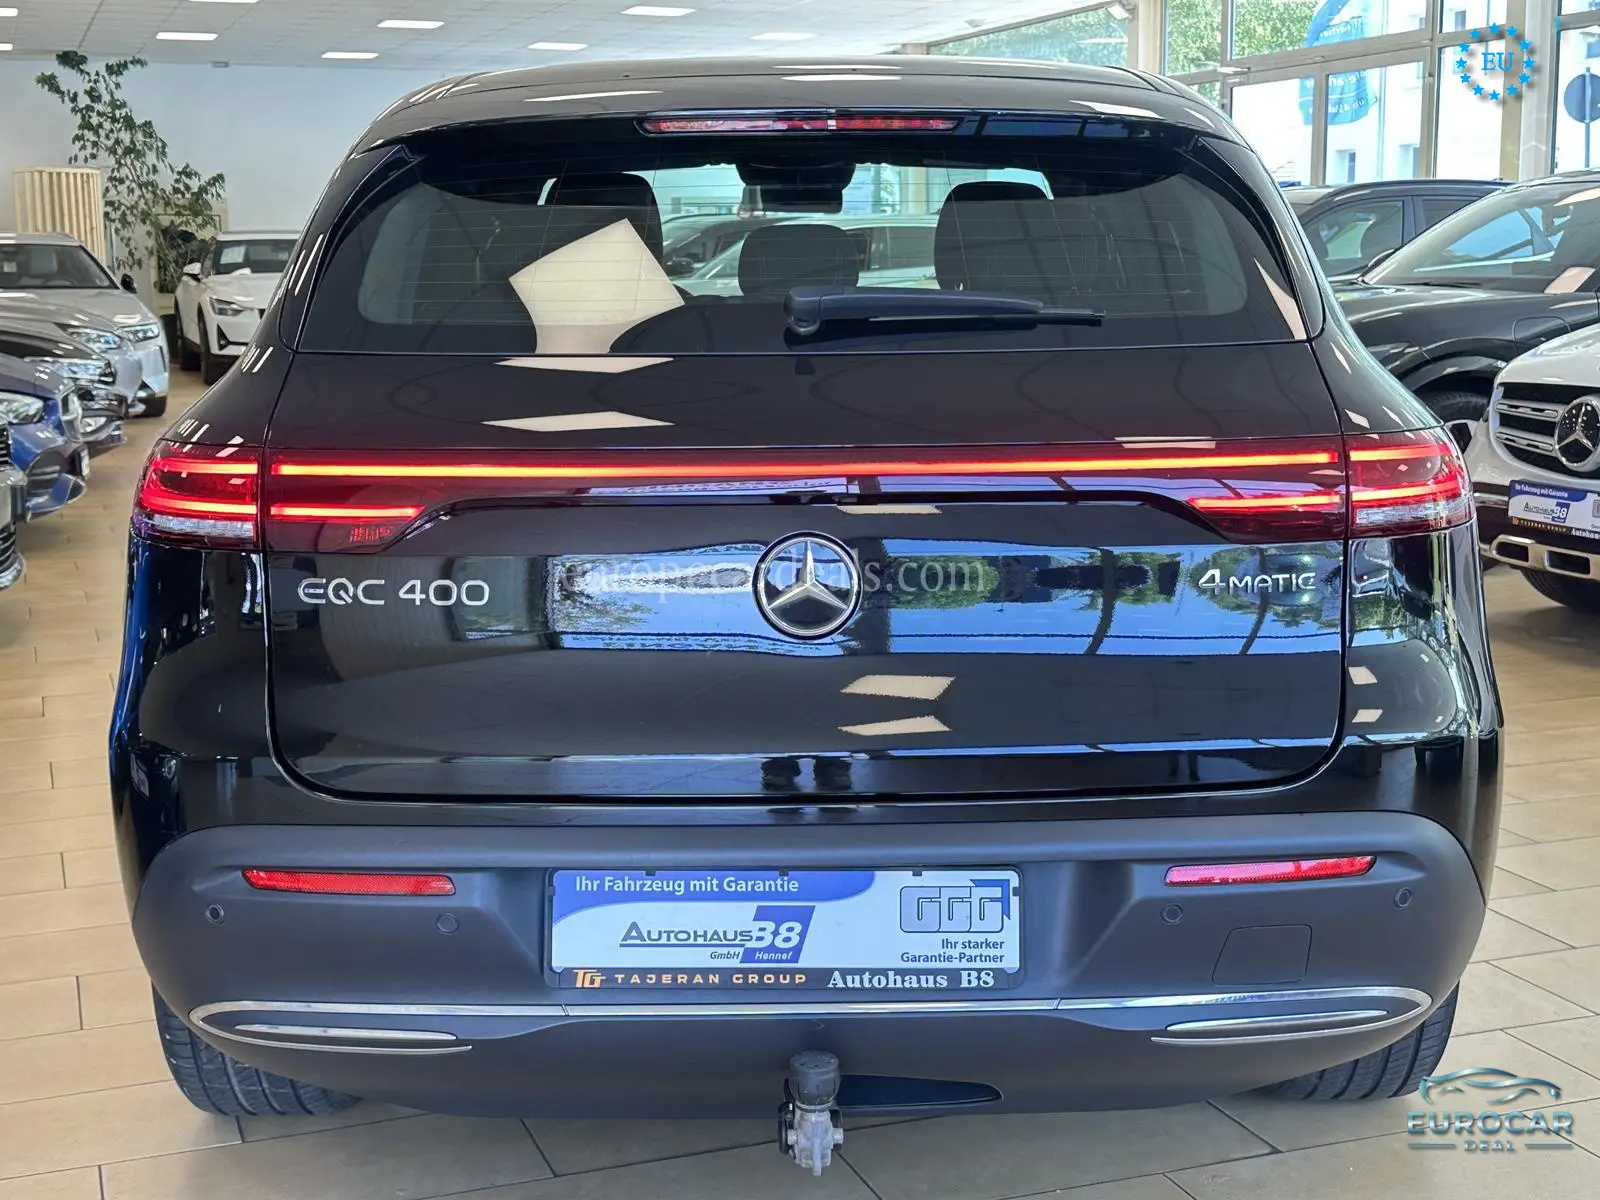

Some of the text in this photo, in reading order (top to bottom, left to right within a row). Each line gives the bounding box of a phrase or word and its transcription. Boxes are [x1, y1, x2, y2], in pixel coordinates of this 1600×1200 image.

[1571, 528, 1600, 540] Autohau
[1198, 568, 1316, 595] 4MATIC
[298, 577, 490, 606] EQC 400
[575, 876, 799, 895] Ihr Fahrzeug mit Garantie
[941, 938, 1005, 950] Ihr starker
[710, 951, 793, 960] GmbH Hennef
[900, 952, 1005, 963] Garantie-Partner
[614, 974, 720, 984] TAJERAN
[732, 974, 807, 984] GROUP
[827, 970, 948, 988] Autohaus
[959, 970, 995, 988] B8
